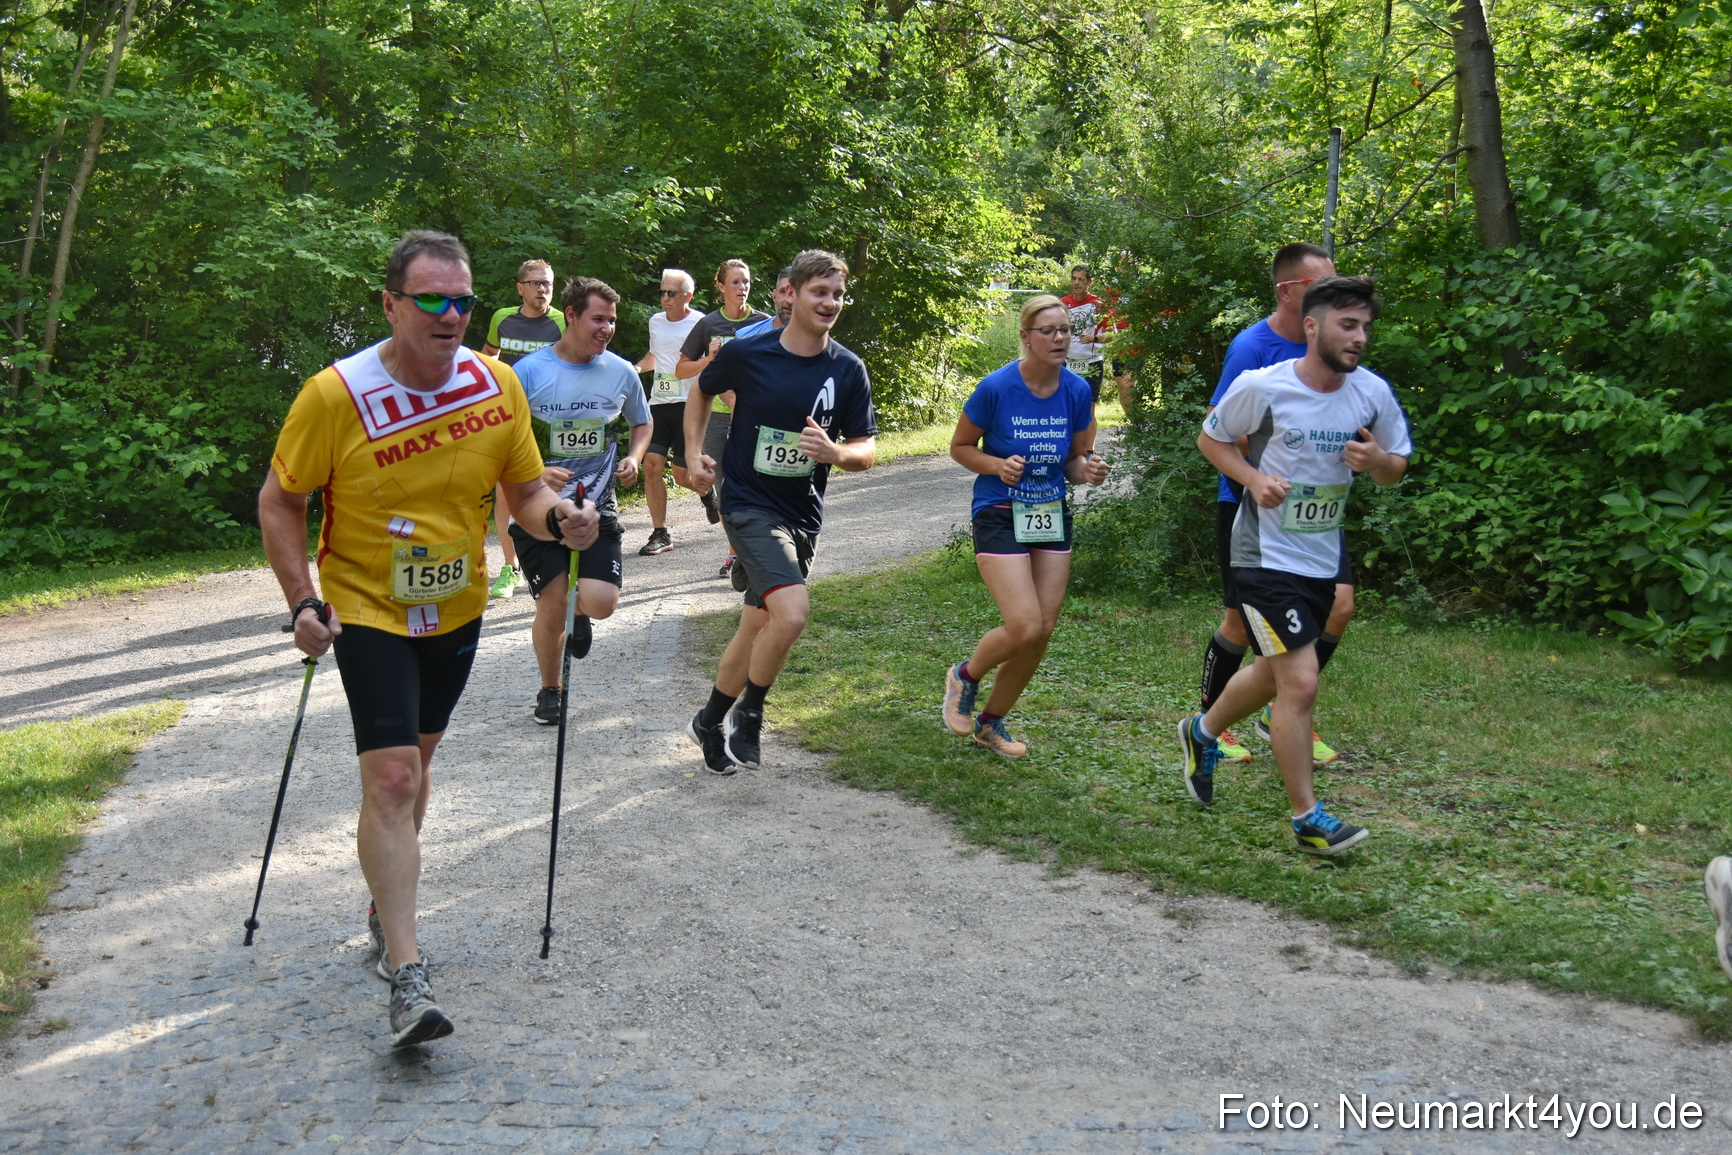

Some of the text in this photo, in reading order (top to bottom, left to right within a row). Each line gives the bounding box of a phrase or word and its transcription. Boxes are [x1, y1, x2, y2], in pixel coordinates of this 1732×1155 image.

[659, 381, 671, 391] 83
[540, 401, 599, 413] RAIL.ONE
[1011, 416, 1038, 426] Wenn
[1039, 418, 1049, 426] es
[373, 405, 513, 469] MAX BÖGL
[557, 431, 598, 447] 1946
[764, 444, 809, 465] 1934
[1029, 442, 1057, 453] richtig
[1023, 454, 1061, 464] LAUFEN
[1293, 501, 1339, 520] 1010
[1025, 513, 1052, 530] 733
[403, 559, 463, 587] 1588
[408, 586, 437, 594] Gürteler
[438, 581, 459, 591] Eduard
[1285, 608, 1302, 634] 3
